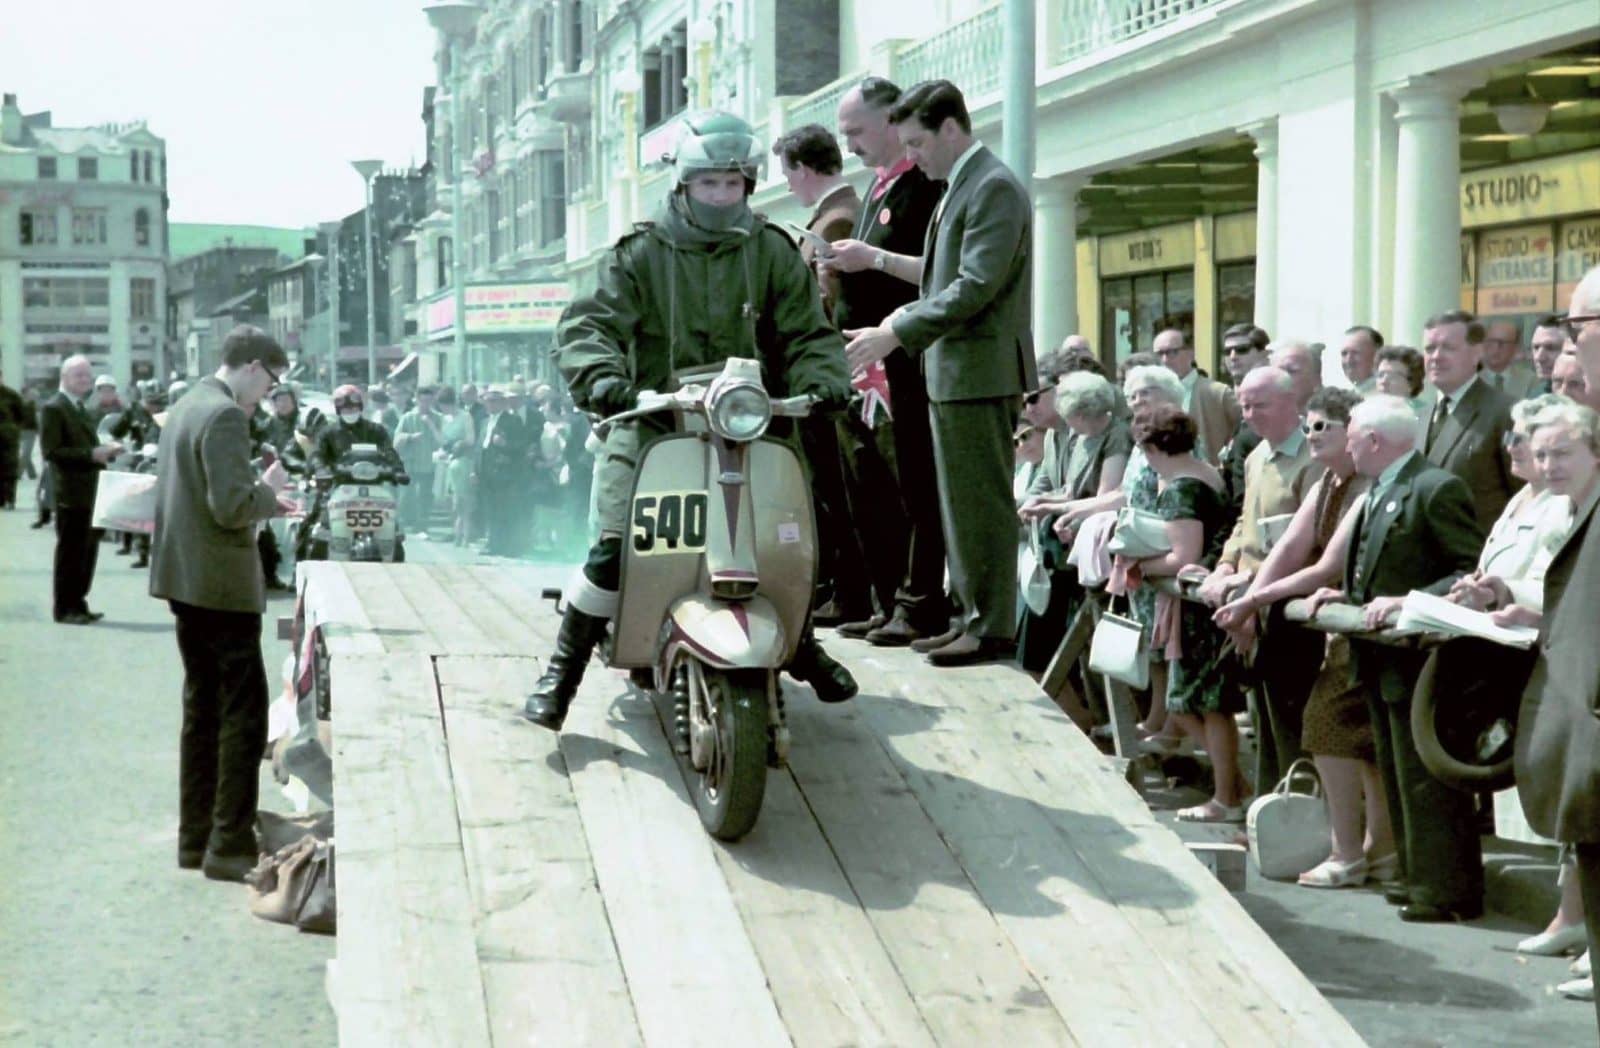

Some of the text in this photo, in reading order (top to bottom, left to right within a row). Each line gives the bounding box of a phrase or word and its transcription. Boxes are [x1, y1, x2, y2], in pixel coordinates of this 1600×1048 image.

[1464, 174, 1542, 209] STUDIO
[1484, 236, 1529, 259] STUDIO
[1567, 222, 1600, 250] CAM
[346, 510, 383, 527] 555
[634, 494, 708, 551] 540
